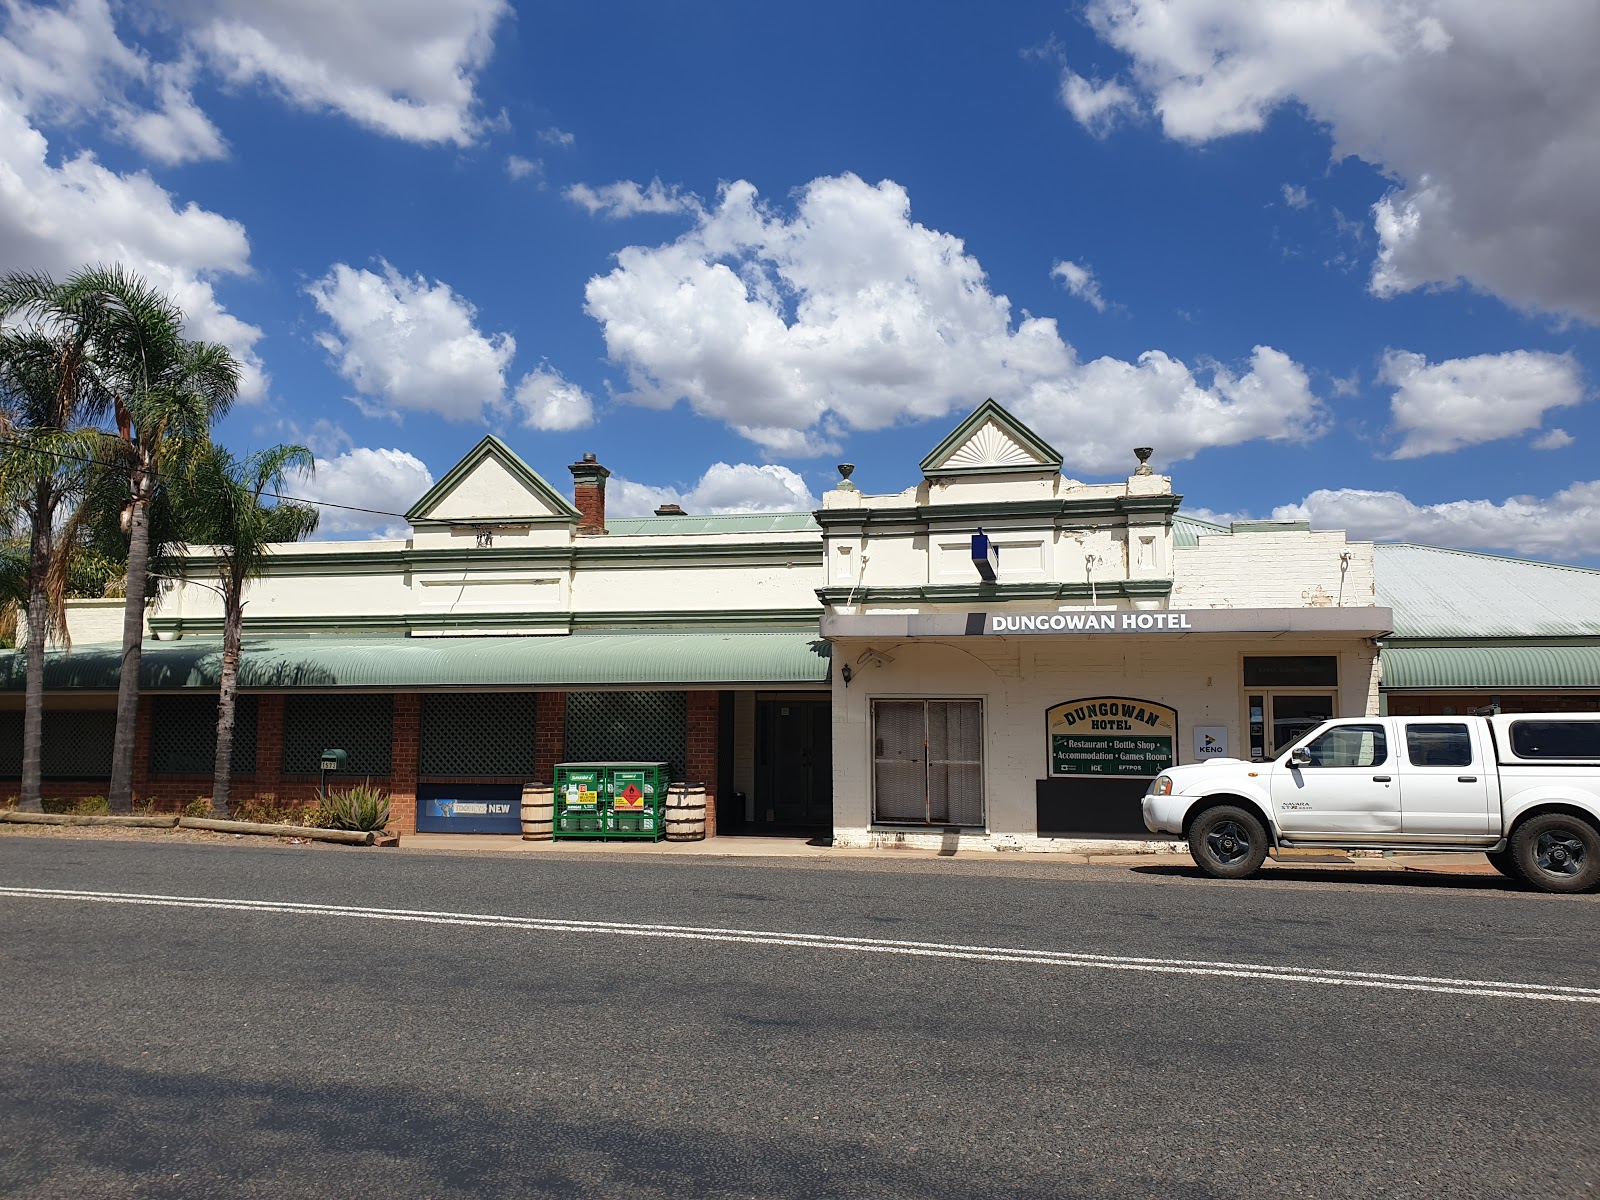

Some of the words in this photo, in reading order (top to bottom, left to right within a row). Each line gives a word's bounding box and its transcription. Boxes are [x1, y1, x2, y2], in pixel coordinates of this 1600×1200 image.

[992, 614, 1115, 631] DUNGOWAN
[1122, 613, 1191, 630] HOTEL
[1063, 703, 1159, 727] DUNGOWAN
[1091, 719, 1132, 730] HOTEL
[1068, 739, 1108, 749] Restaurant
[1114, 740, 1135, 749] Bottle
[1136, 741, 1155, 751] Shop
[1057, 751, 1114, 760] Accommodation
[1120, 752, 1145, 761] Games
[1146, 752, 1167, 761] Room
[488, 804, 510, 813] NEW
